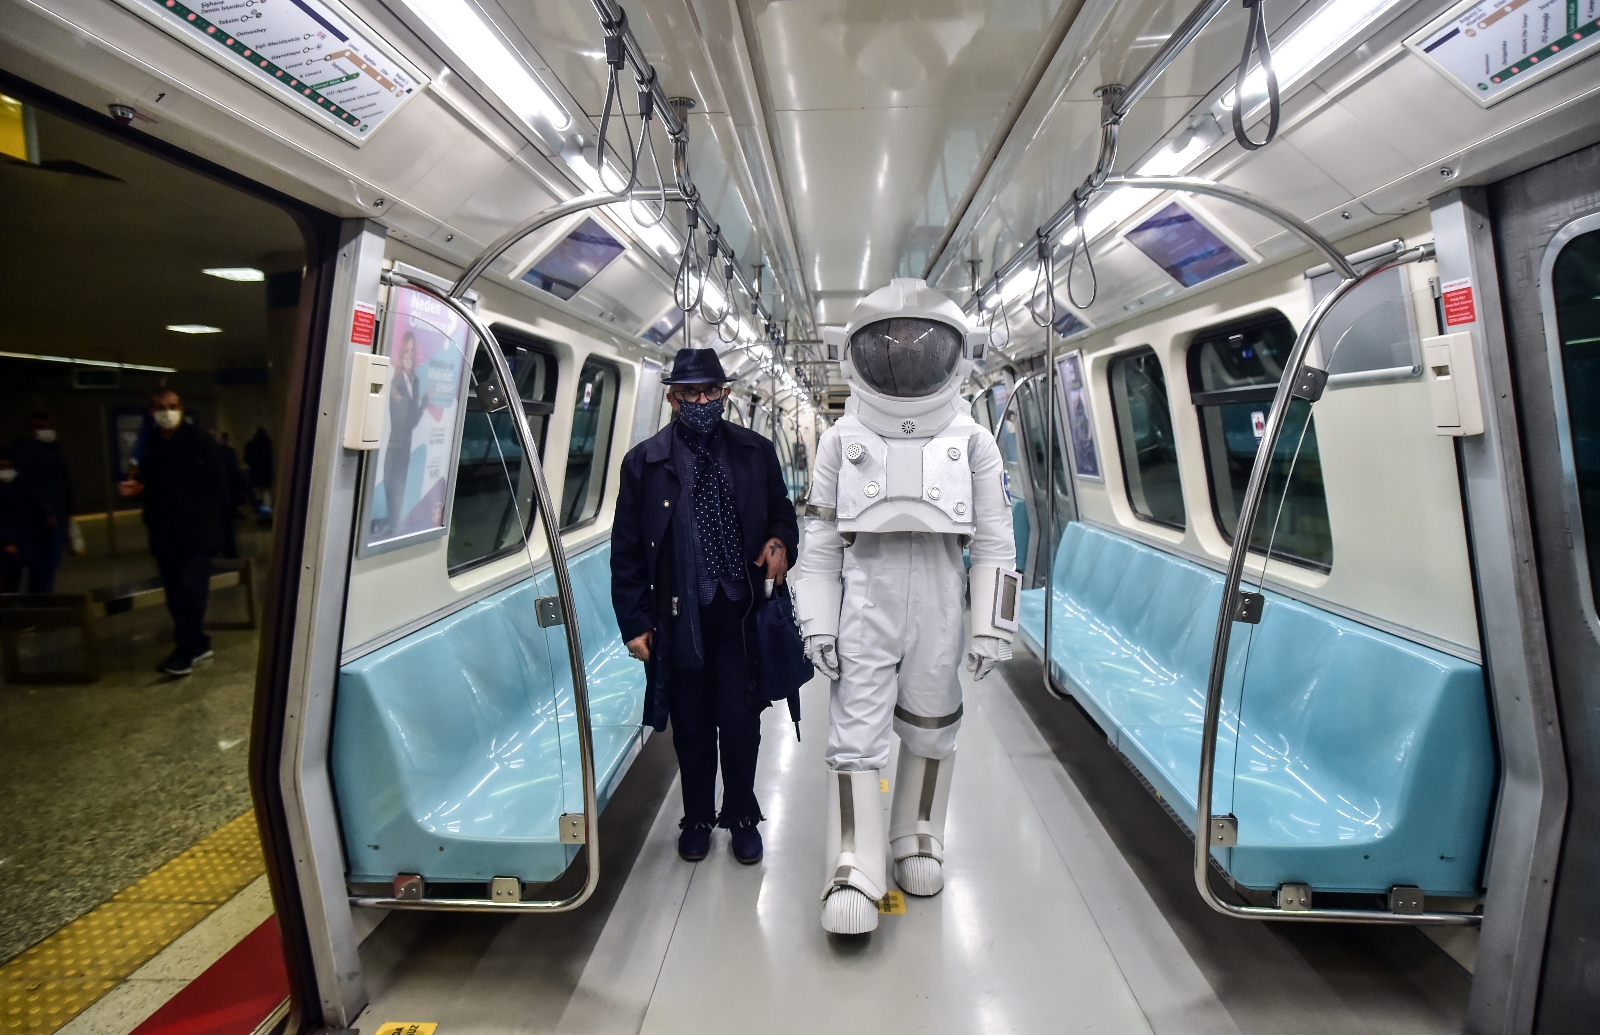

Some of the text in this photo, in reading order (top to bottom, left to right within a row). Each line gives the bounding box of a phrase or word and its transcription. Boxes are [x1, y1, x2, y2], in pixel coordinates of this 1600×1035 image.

[218, 17, 240, 25] Taksim
[236, 27, 267, 37] Osmanbey
[155, 92, 166, 103] 1
[410, 291, 442, 316] Neden
